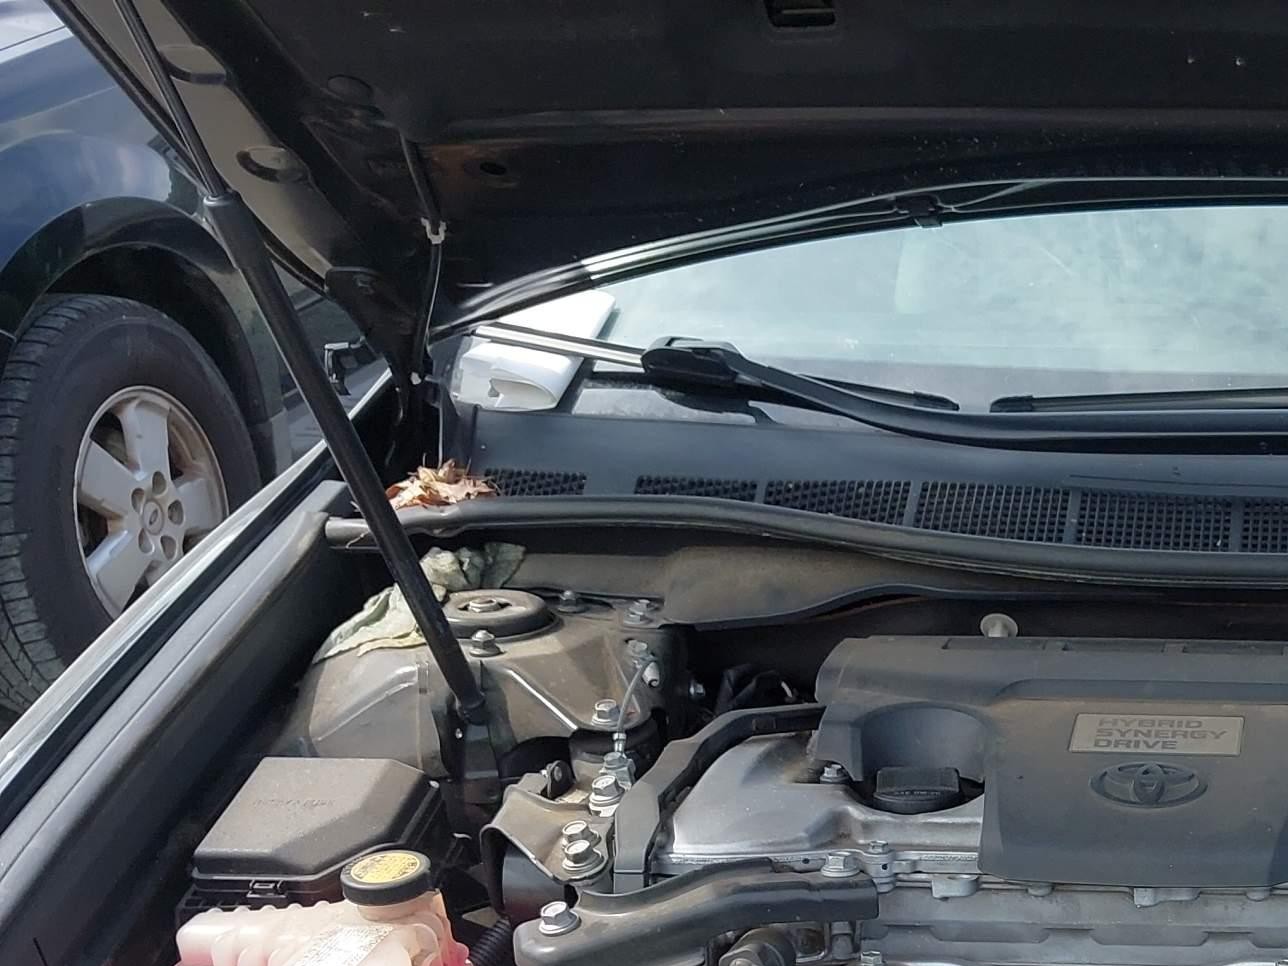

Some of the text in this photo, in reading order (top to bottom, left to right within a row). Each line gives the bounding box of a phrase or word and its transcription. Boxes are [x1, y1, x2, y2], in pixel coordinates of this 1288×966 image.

[1099, 718, 1203, 729] HYBRID
[1095, 728, 1227, 740] SYNERGY
[1093, 738, 1178, 750] DRIVE
